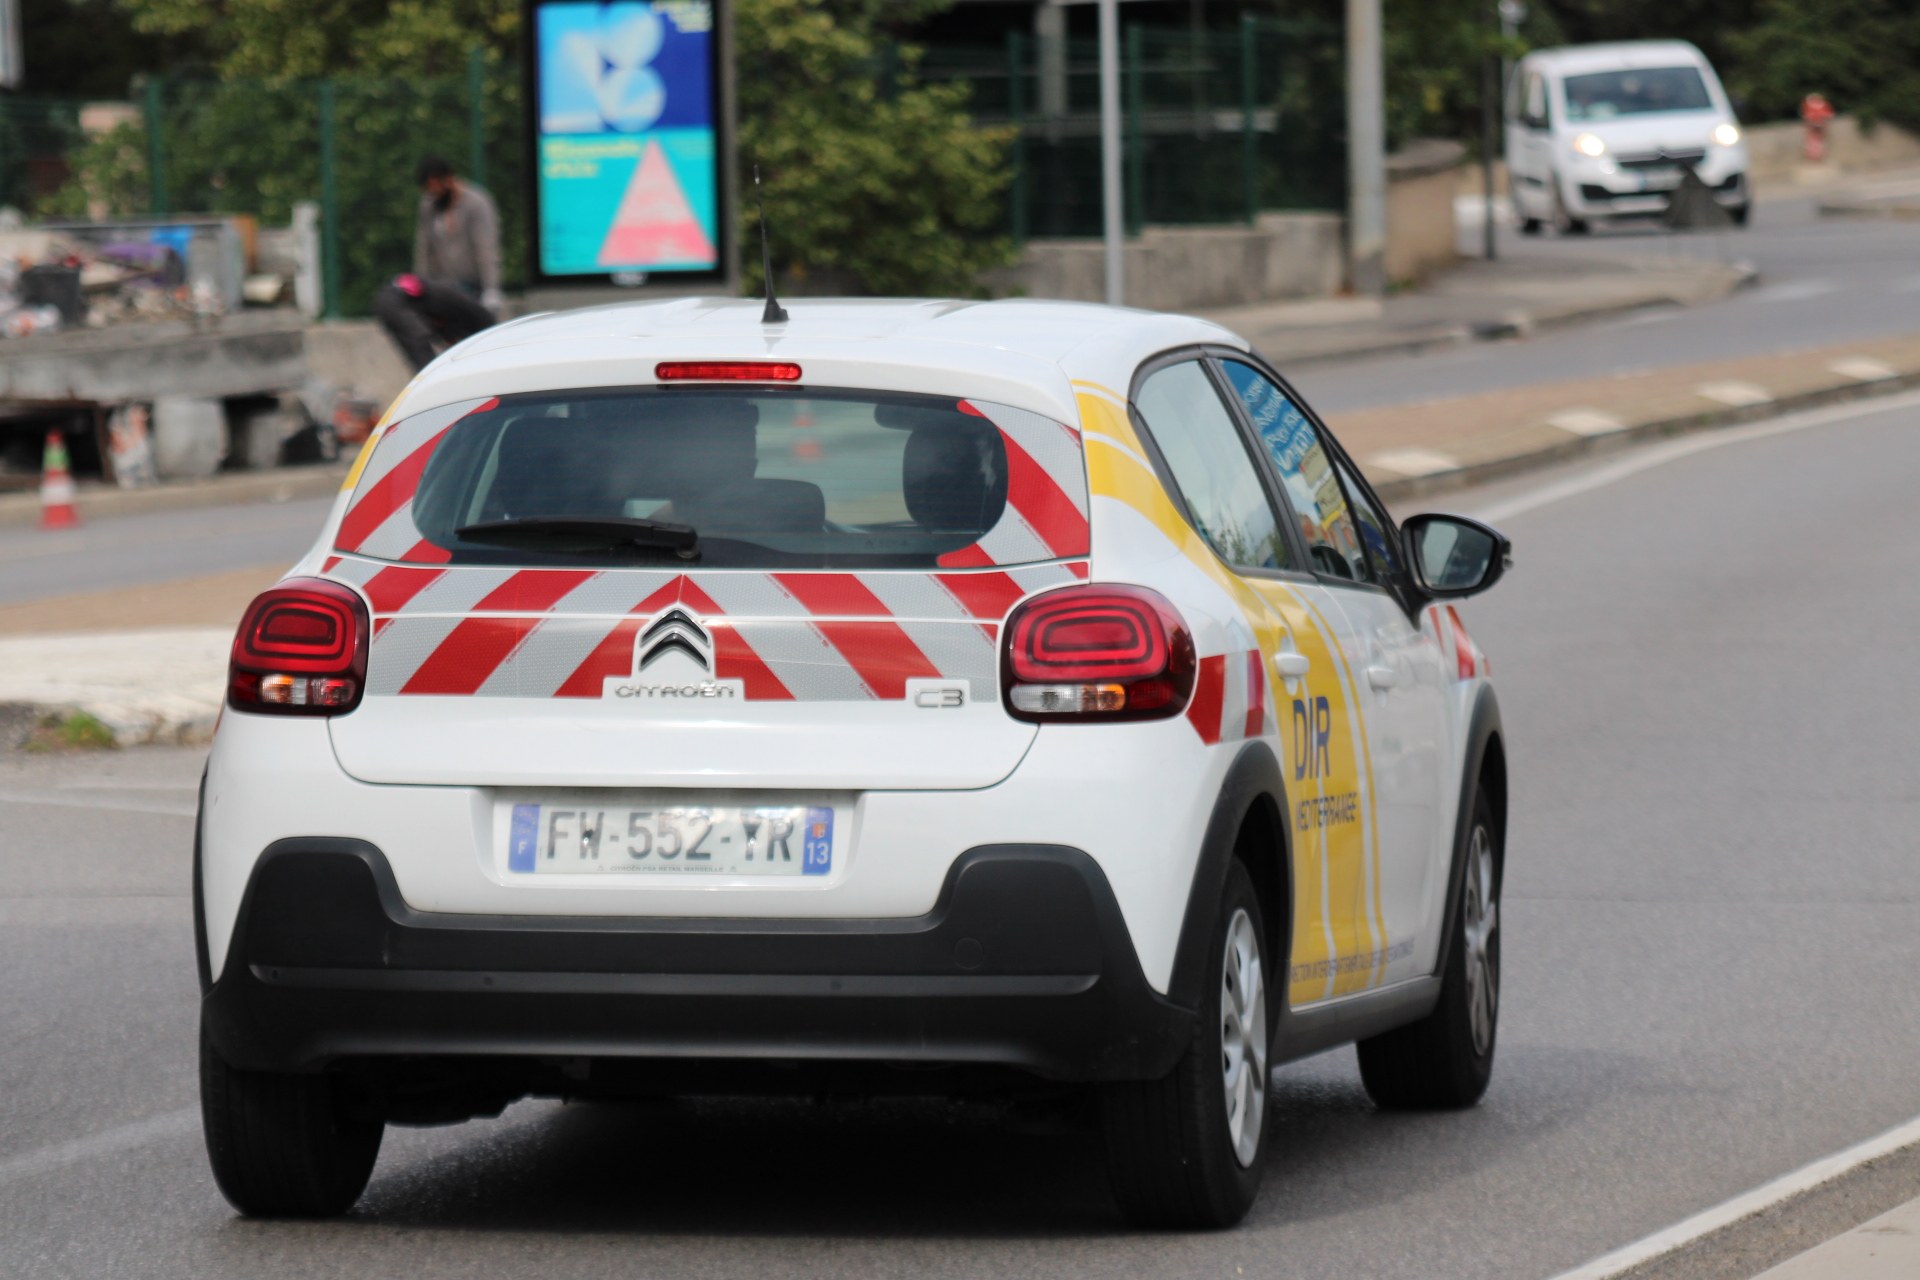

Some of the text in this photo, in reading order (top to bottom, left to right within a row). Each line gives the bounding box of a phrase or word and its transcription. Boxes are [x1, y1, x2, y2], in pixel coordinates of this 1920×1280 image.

[914, 687, 965, 708] C3
[1292, 696, 1331, 782] DIR
[547, 810, 794, 862] FW-552-YR
[516, 840, 527, 856] F
[806, 842, 830, 865] 13
